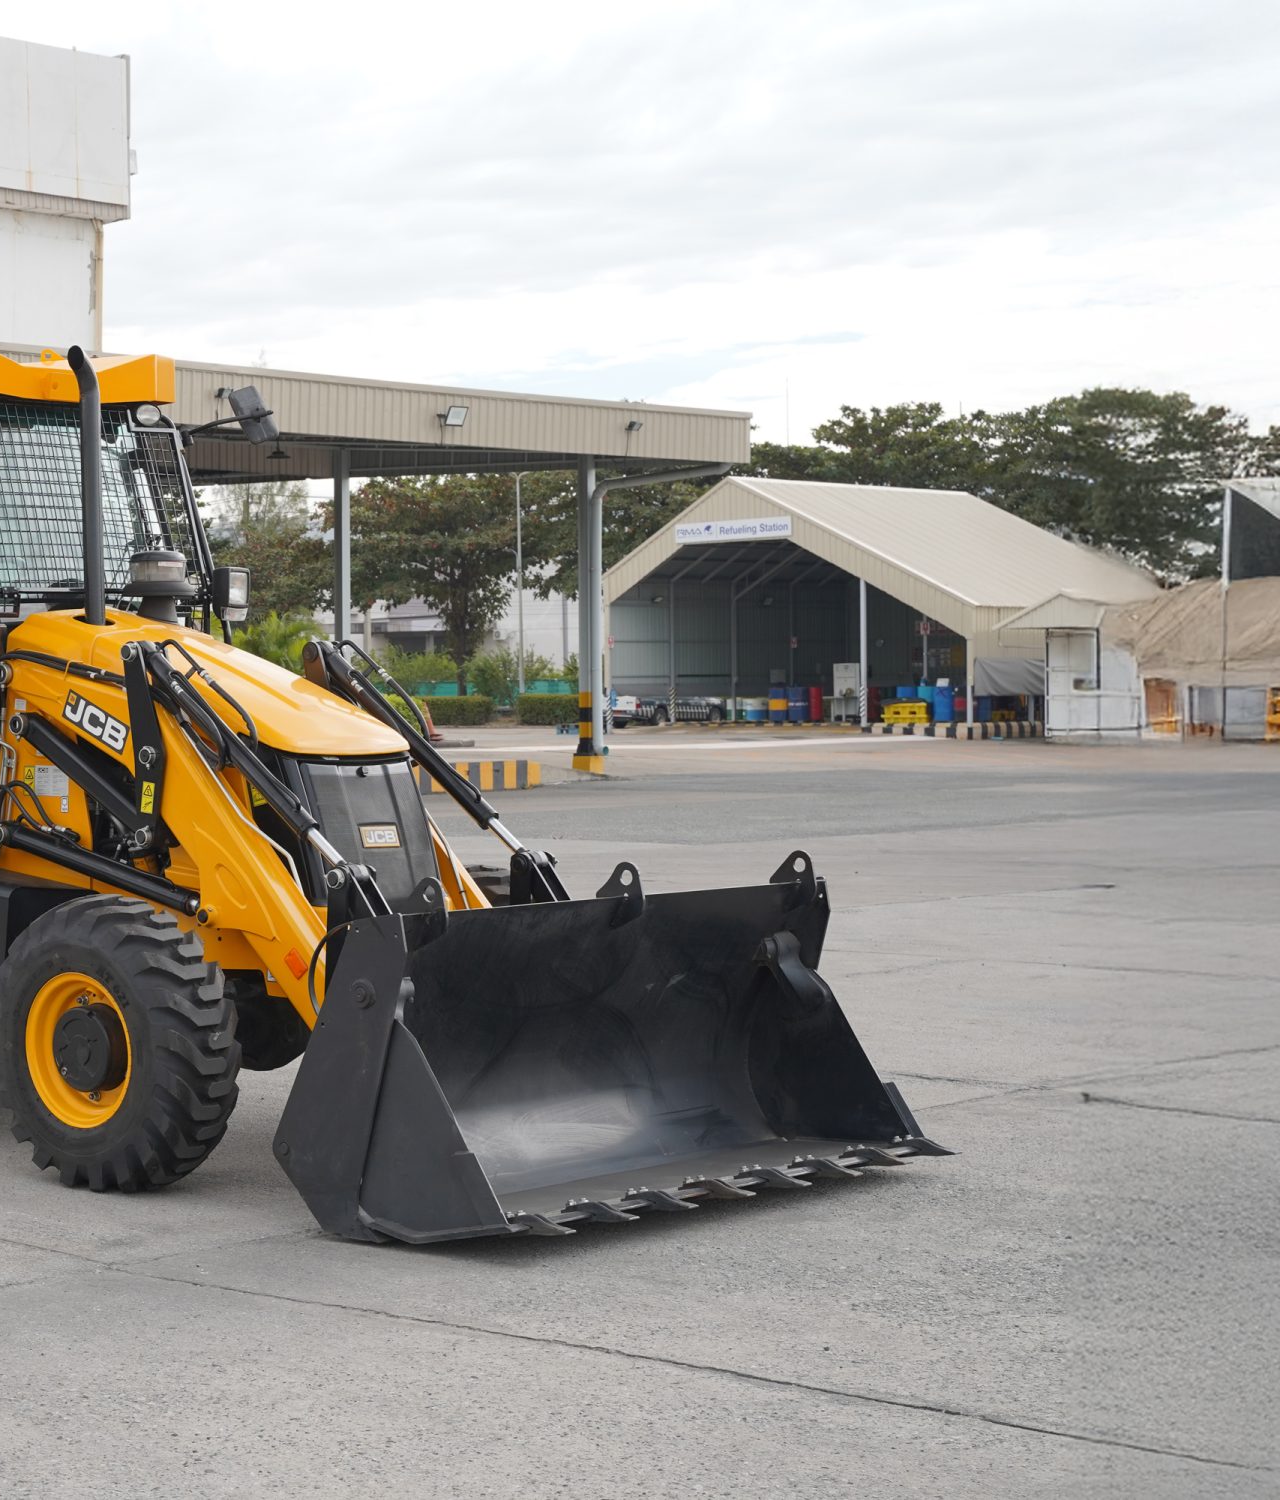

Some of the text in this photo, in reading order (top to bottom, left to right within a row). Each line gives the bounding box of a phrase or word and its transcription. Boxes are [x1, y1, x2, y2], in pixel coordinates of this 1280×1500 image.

[720, 525, 757, 536] Refueling
[759, 522, 789, 533] Station
[64, 698, 127, 751] JCB
[366, 830, 397, 843] JCB
